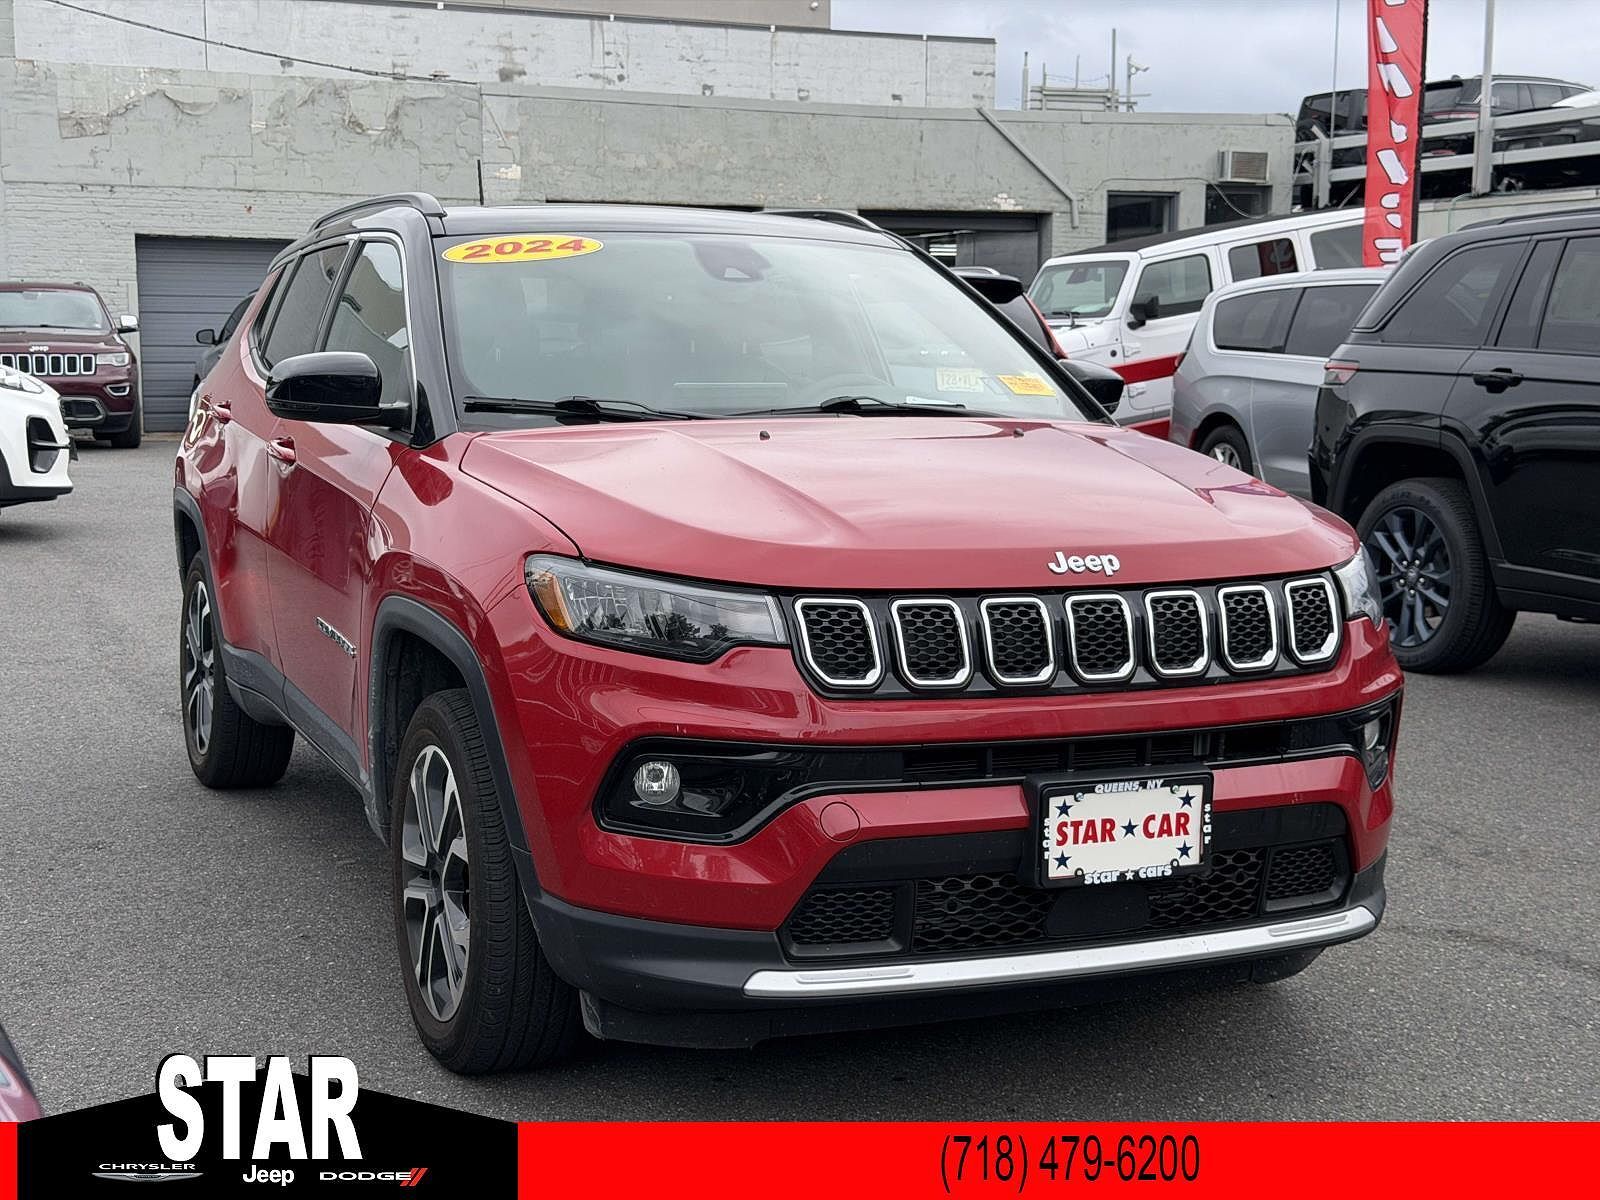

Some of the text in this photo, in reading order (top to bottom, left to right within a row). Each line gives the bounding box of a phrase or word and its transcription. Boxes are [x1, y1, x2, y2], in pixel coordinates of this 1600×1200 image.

[463, 239, 586, 260] 2024
[1046, 551, 1120, 576] Jeep
[1094, 779, 1164, 794] QUEENS, NY
[1055, 812, 1191, 847] STAR CAR
[1203, 803, 1212, 845] star
[1084, 864, 1173, 885] star cars
